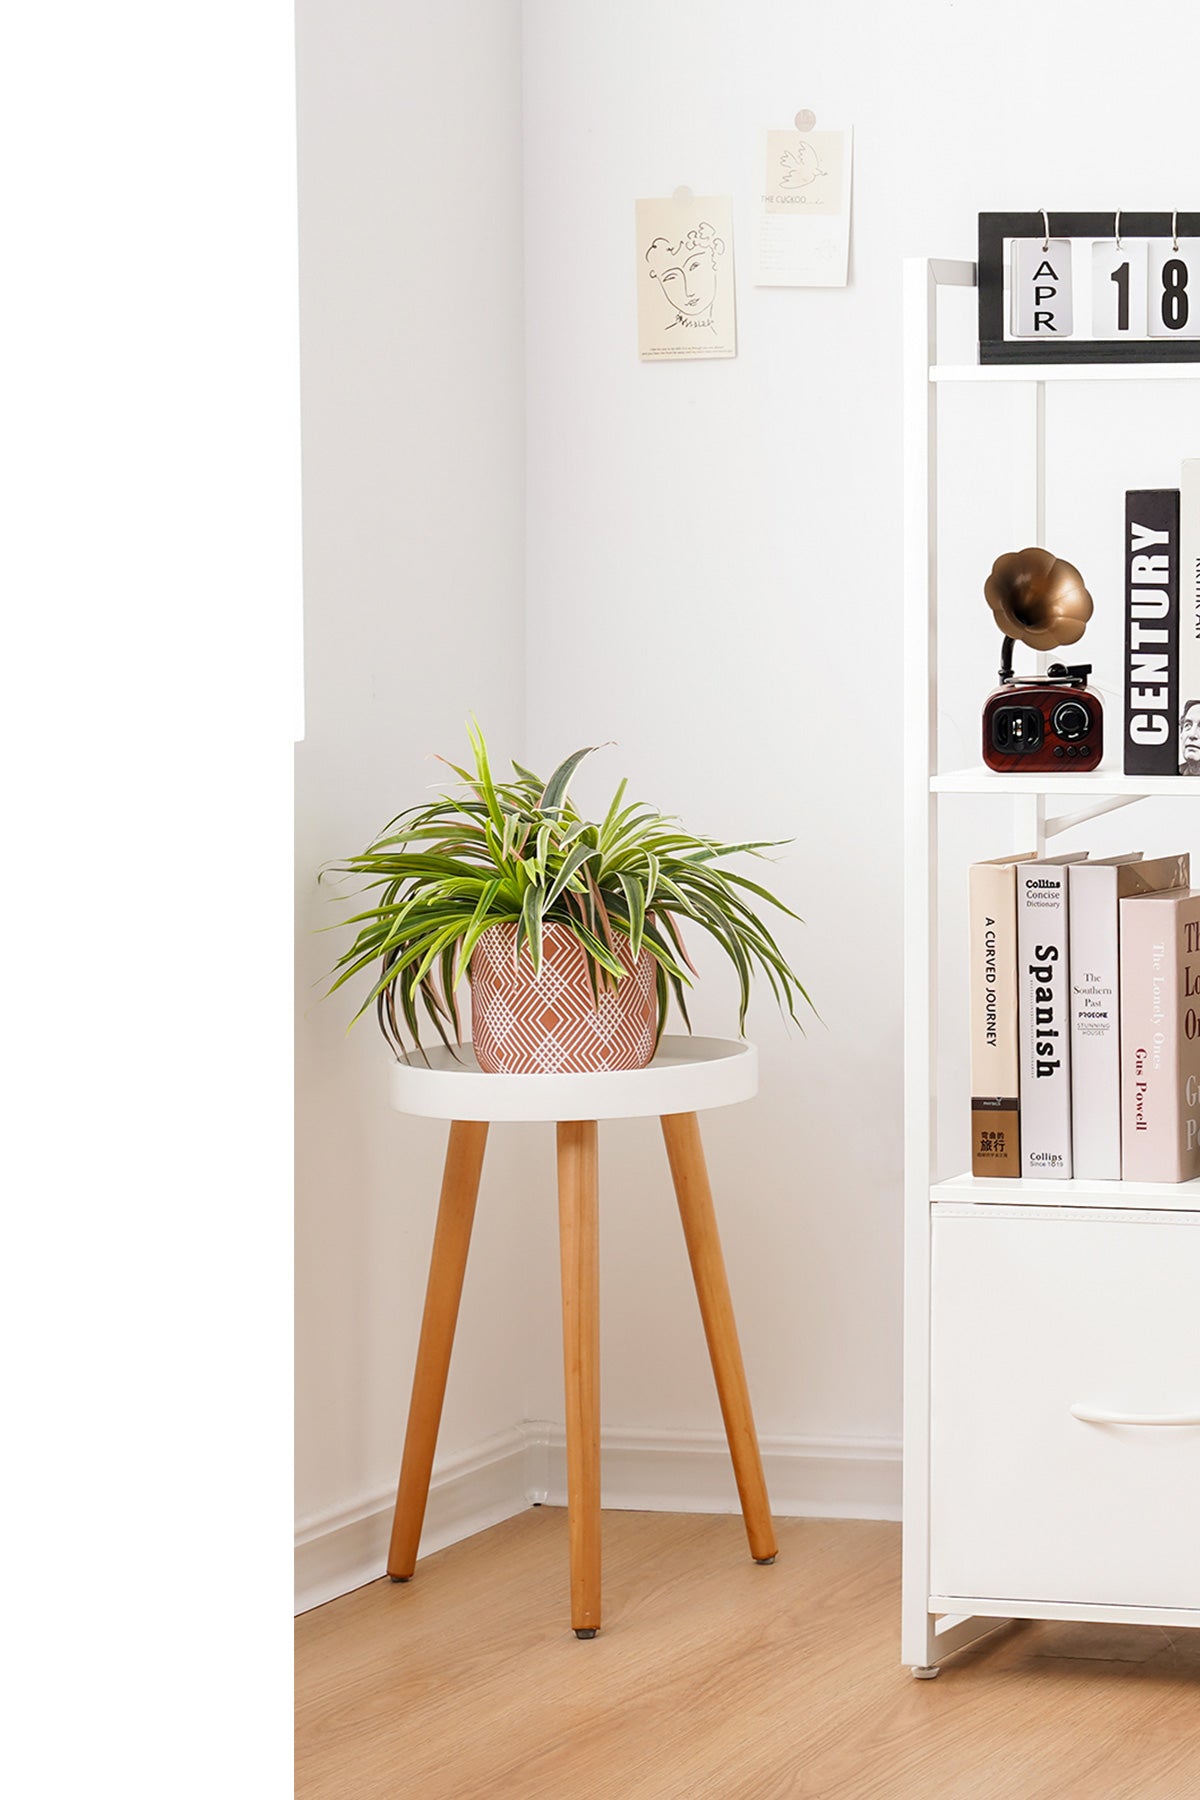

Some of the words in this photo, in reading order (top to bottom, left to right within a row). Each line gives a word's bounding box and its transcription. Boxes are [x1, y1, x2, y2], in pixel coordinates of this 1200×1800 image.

[761, 195, 774, 204] THE
[1032, 261, 1060, 332] APR
[1129, 522, 1170, 746] CENTURY
[1026, 879, 1061, 888] Collins
[1026, 890, 1060, 899] Concise
[1026, 900, 1060, 909] Dictionary
[985, 917, 995, 926] A
[985, 930, 996, 983] CURVED
[1153, 942, 1165, 971] The
[1083, 973, 1102, 982] The
[1073, 985, 1112, 995] Southern
[1084, 998, 1102, 1007] Past
[1150, 976, 1165, 1026] Lonely
[985, 987, 996, 1047] JOURNEY
[1029, 945, 1060, 1079] Spanish
[1153, 1032, 1165, 1071] Ones
[1135, 1048, 1147, 1076] Gus
[1135, 1082, 1147, 1131] Powell
[979, 1139, 1005, 1152] 旅行
[1030, 1152, 1063, 1161] Collins
